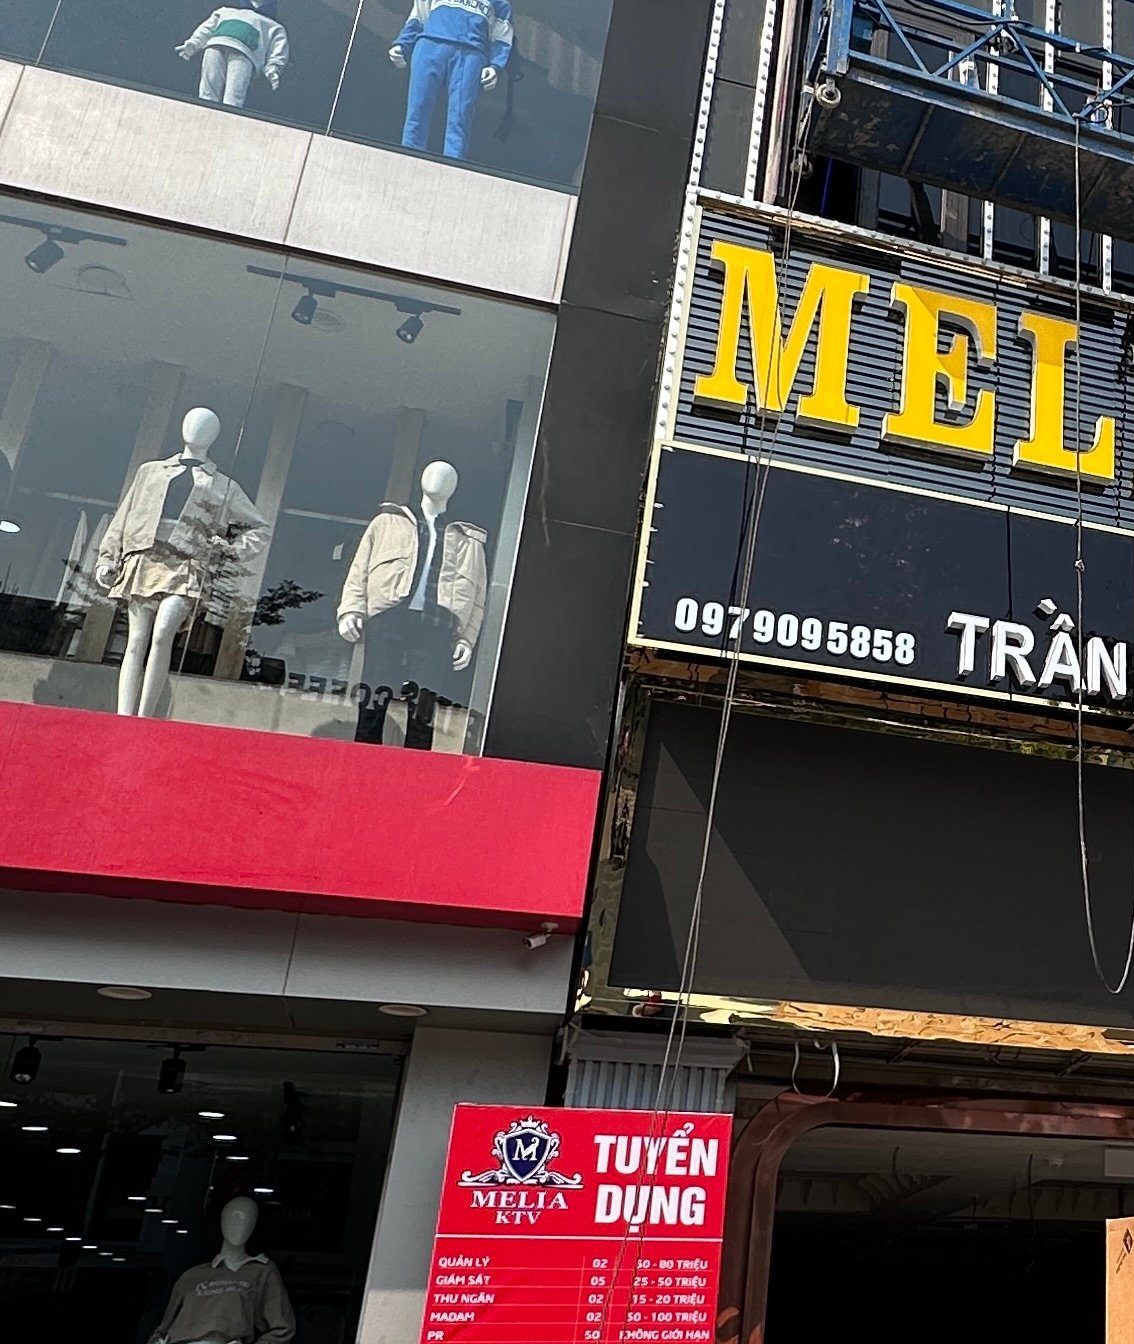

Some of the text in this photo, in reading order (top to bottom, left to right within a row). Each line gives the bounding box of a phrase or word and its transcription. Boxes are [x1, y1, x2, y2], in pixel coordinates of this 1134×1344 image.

[674, 596, 916, 666] 0979095858
[945, 597, 1127, 700] TRẦN
[594, 1122, 719, 1176] TUYỂN
[470, 1190, 568, 1210] MELIA
[594, 1184, 706, 1233] DỤNG
[495, 1211, 541, 1225] KTV
[438, 1255, 472, 1267] QUẢN
[592, 1259, 608, 1269] 02
[676, 1258, 708, 1271] TRIỆU
[435, 1274, 465, 1285] GIÁM
[468, 1274, 491, 1285] SÁT
[590, 1276, 606, 1286] 05
[633, 1277, 648, 1287] 25
[657, 1277, 672, 1286] 50
[675, 1276, 706, 1288] TRIỆU
[433, 1293, 458, 1303] THU
[588, 1294, 604, 1304] 02
[632, 1295, 646, 1304] 15
[655, 1295, 671, 1304] 20
[673, 1293, 705, 1306] TRIỆU
[430, 1312, 475, 1322] MADAM
[586, 1312, 601, 1322] 02
[651, 1312, 673, 1322] 100
[675, 1311, 707, 1323] TRIỆU
[427, 1331, 444, 1340] PR
[584, 1330, 600, 1340] 50
